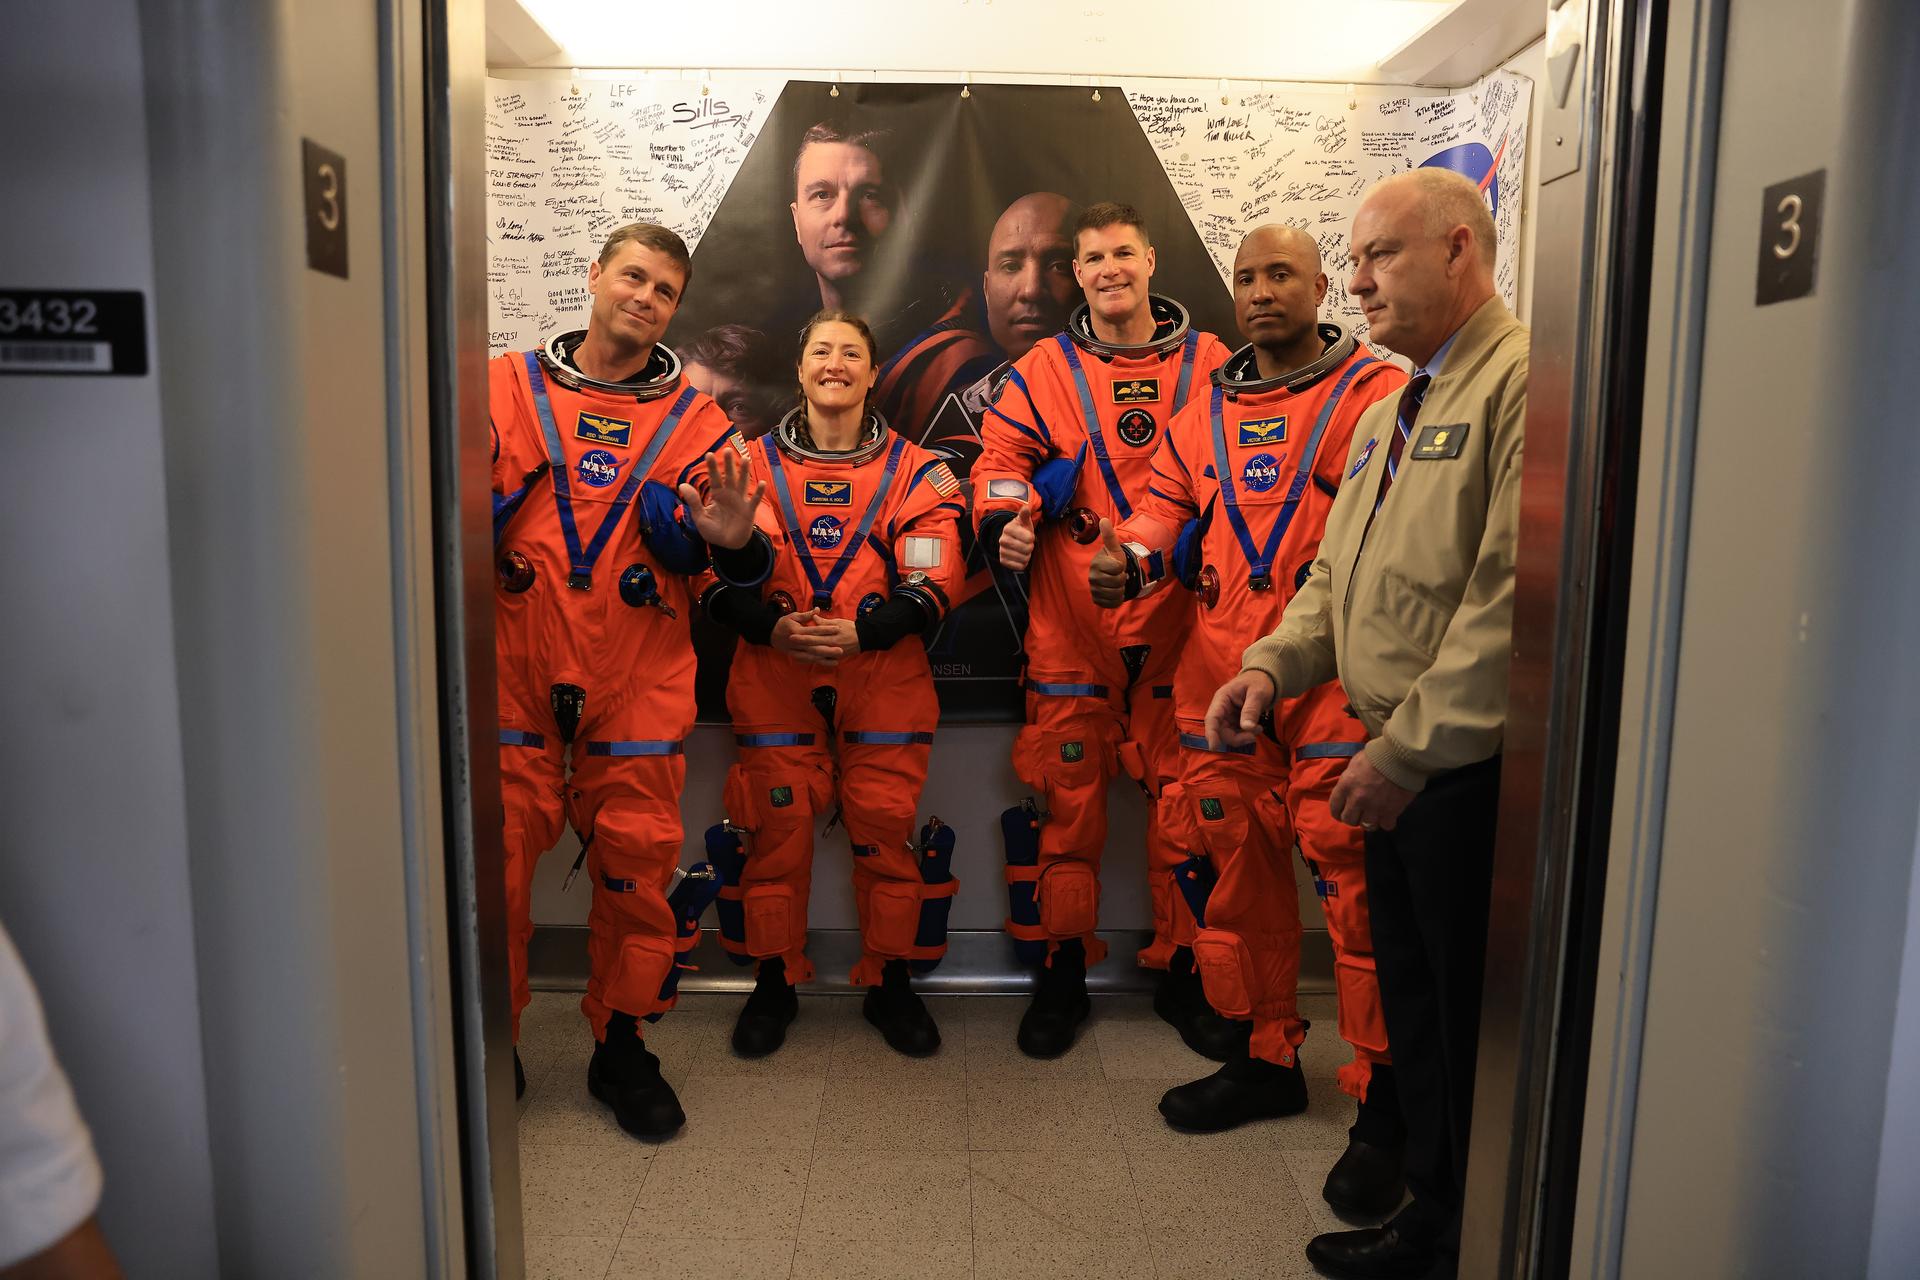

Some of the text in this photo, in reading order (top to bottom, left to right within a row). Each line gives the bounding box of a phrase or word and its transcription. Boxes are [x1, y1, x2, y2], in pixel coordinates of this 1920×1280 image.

[610, 83, 638, 97] LFG
[1129, 92, 1137, 101] I
[1156, 97, 1168, 105] you
[1170, 94, 1186, 104] have
[672, 98, 730, 123] Sills
[651, 153, 665, 161] HAVE
[490, 169, 544, 179] FLY STRAIGHT!
[318, 163, 339, 231] 3
[545, 197, 567, 209] Enjoy
[1773, 193, 1803, 260] 3
[544, 251, 556, 259] God
[0, 298, 98, 333] 3432
[581, 460, 616, 477] NASA
[1246, 467, 1277, 478] NASA
[812, 527, 841, 537] NASA
[932, 664, 971, 675] NSEN
